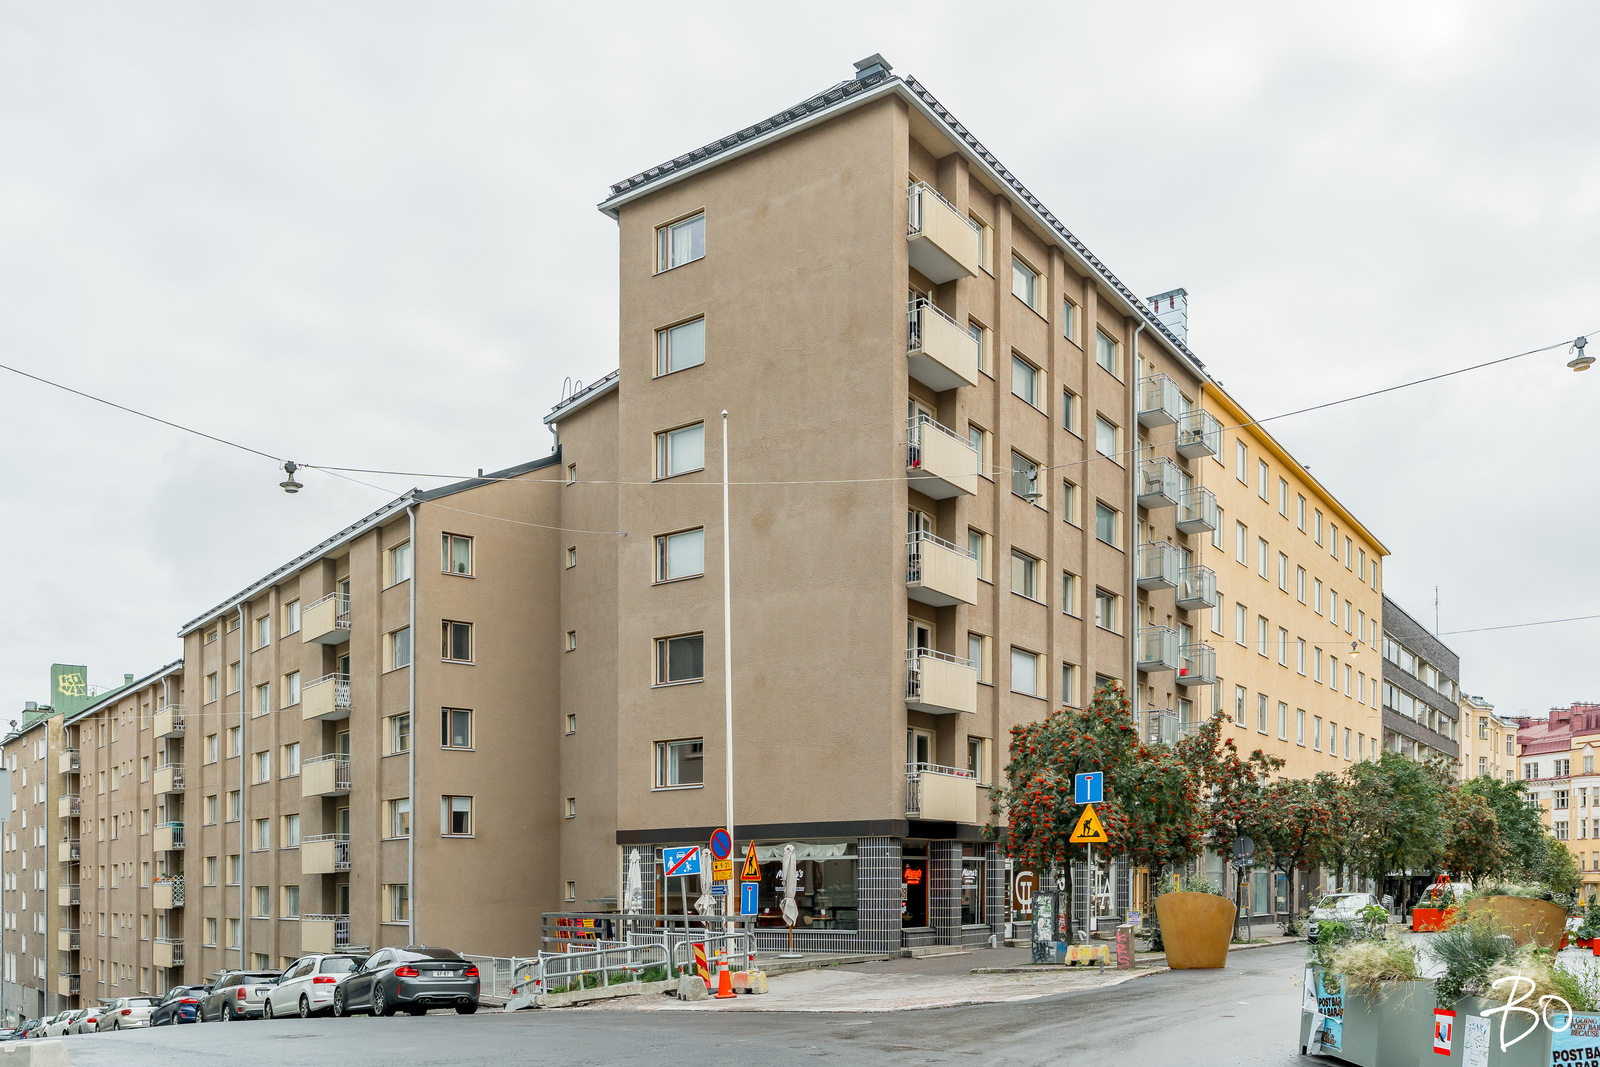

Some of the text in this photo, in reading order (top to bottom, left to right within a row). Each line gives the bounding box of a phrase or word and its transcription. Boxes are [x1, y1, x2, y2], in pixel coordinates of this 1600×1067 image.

[1318, 996, 1342, 1008] POST BAR
[1575, 1016, 1598, 1025] GOING
[1570, 1022, 1587, 1031] POST
[1570, 1029, 1600, 1037] BECAUSE
[1552, 1047, 1584, 1063] POST
